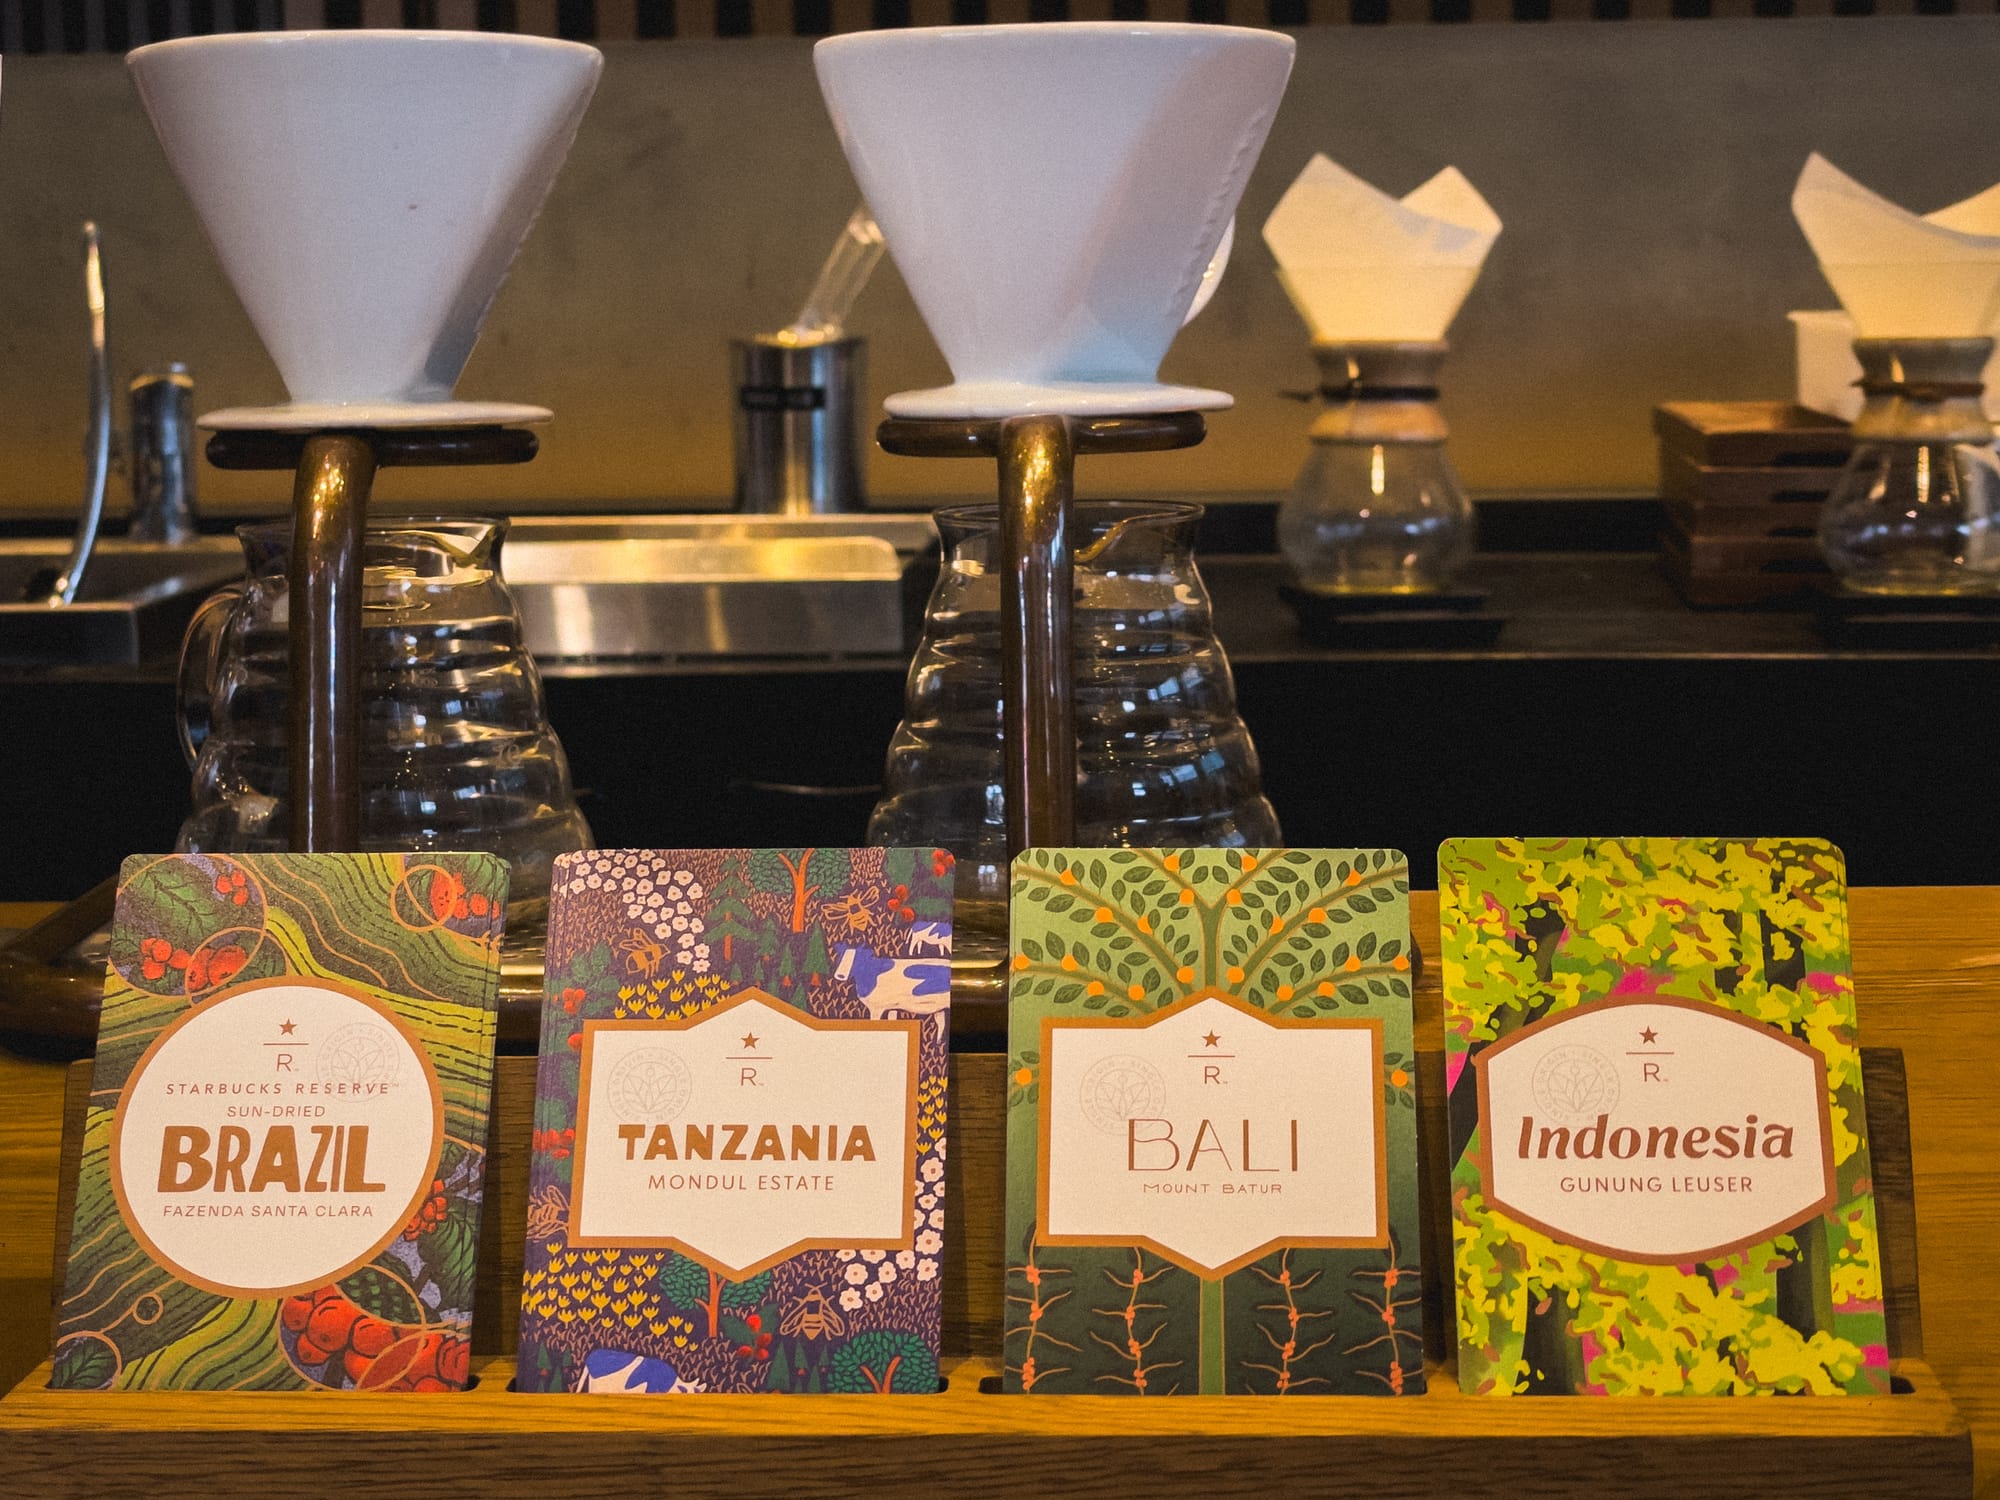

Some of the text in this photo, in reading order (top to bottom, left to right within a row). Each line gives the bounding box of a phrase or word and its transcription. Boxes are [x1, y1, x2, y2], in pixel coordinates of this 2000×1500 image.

[277, 1053, 293, 1073] R
[1643, 1062, 1661, 1083] R
[740, 1067, 757, 1087] R
[1203, 1065, 1220, 1085] R
[166, 1082, 281, 1095] STARBUCKS
[295, 1082, 390, 1095] RESERVE
[226, 1105, 326, 1118] SUN-DRIED
[618, 1124, 877, 1162] TANZANIA
[1127, 1118, 1299, 1173] BALI
[1518, 1113, 1794, 1160] Indonesia
[157, 1125, 386, 1193] BRAZIL
[648, 1174, 834, 1191] MONDUL ESTATE
[1143, 1183, 1283, 1195] MOUNT BATUR
[1560, 1176, 1753, 1193] GUNUNG LEUSER
[163, 1204, 374, 1218] FAZENDA SANTA CLARA
